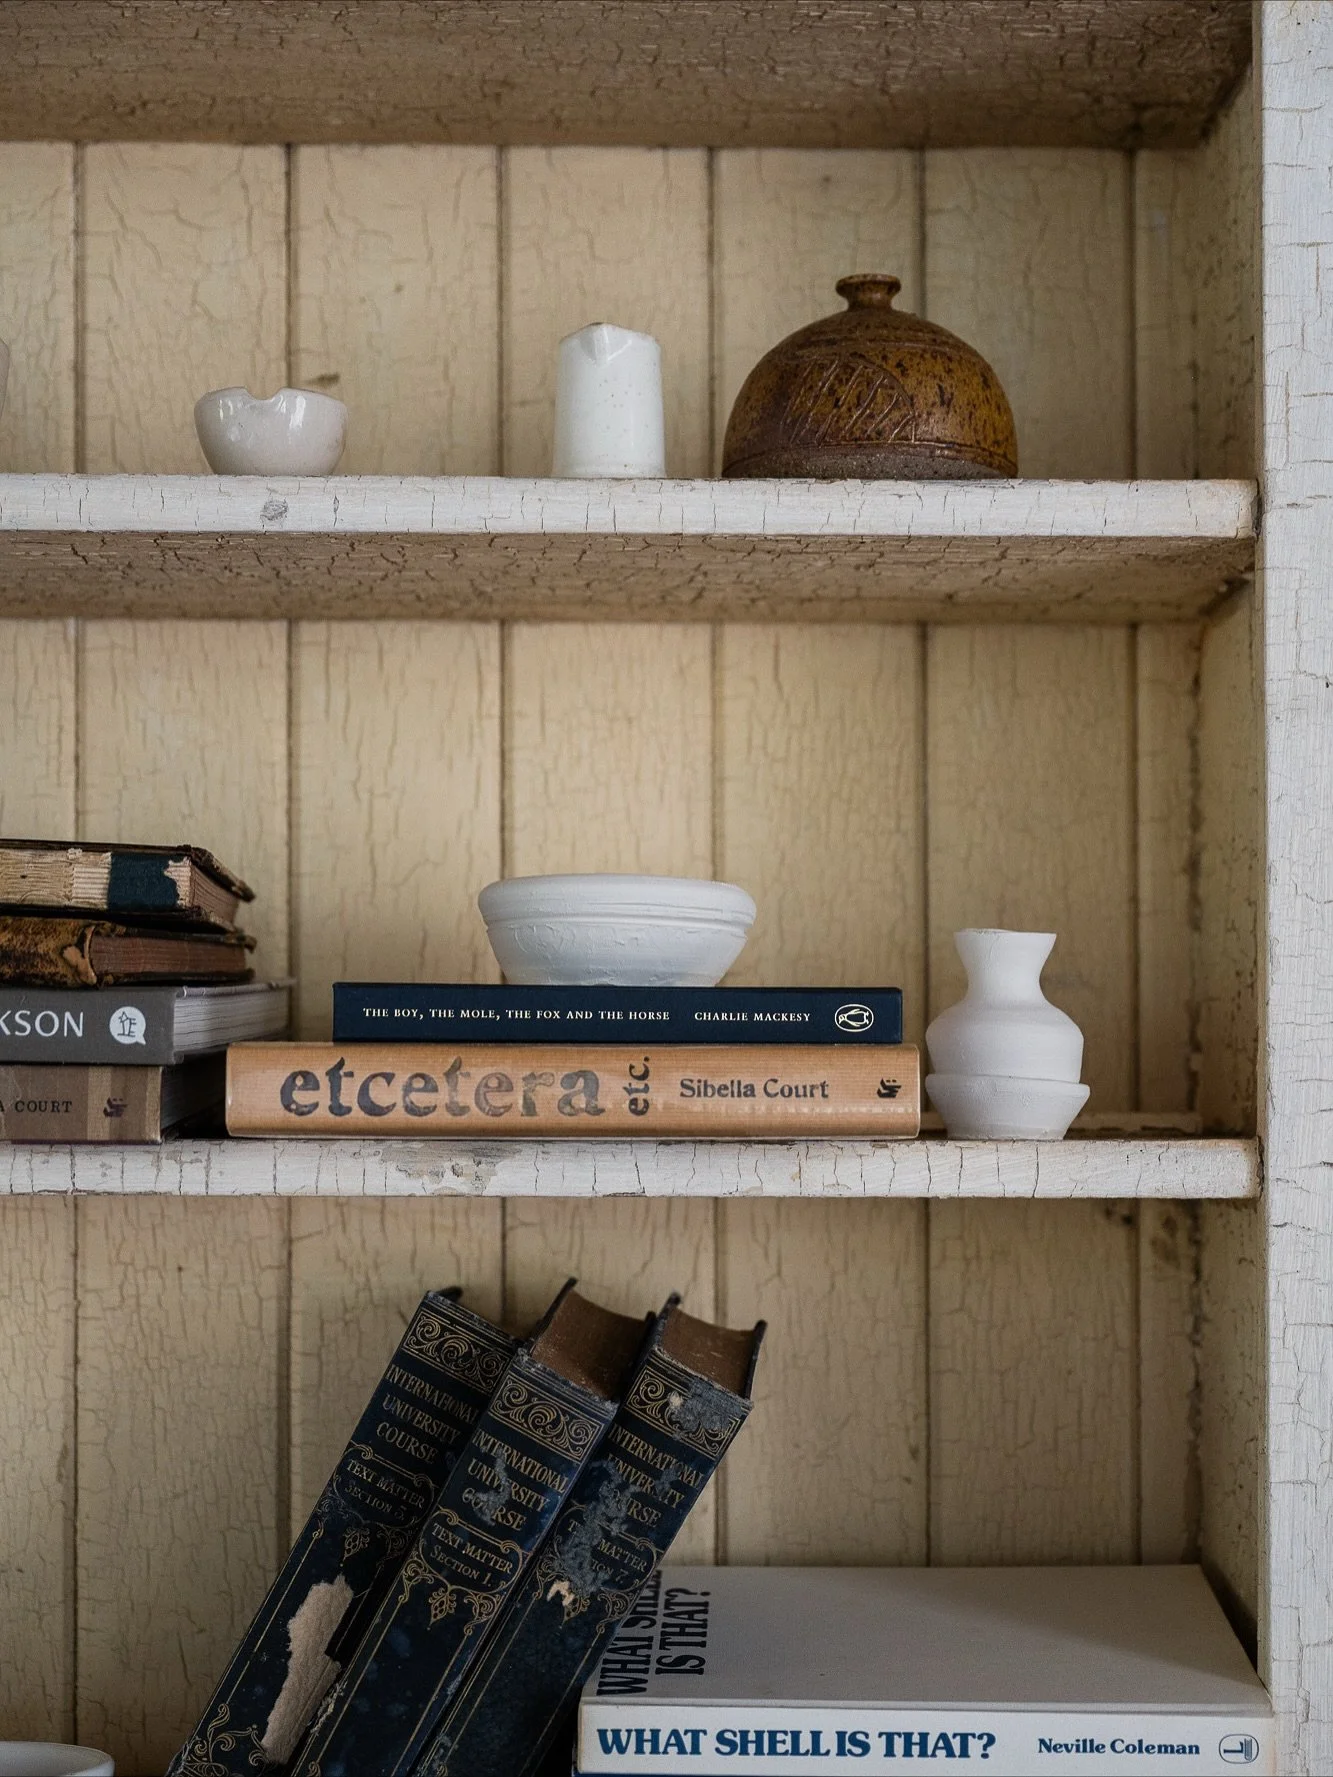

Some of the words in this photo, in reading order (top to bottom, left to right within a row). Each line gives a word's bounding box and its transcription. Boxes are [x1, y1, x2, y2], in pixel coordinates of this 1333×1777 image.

[363, 1008, 389, 1018] THE
[394, 1008, 424, 1020] BOY,
[429, 1008, 455, 1018] THE
[460, 1009, 500, 1021] MOLE,
[505, 1009, 531, 1019] THE
[536, 1009, 561, 1020] FOX
[566, 1010, 593, 1020] AND
[598, 1010, 624, 1020] THE
[629, 1011, 670, 1021] HORSE
[694, 1011, 749, 1022] CHARLIE
[753, 1012, 811, 1022] MACKESY
[15, 1100, 73, 1113] COURT
[279, 1056, 606, 1117] etcetera
[622, 1055, 650, 1116] etc.
[679, 1078, 756, 1099] Sibella
[763, 1078, 829, 1099] Court
[385, 1363, 479, 1425] INTERNATIONAL
[382, 1392, 462, 1446] UNIVERSITY
[376, 1421, 439, 1465] COURSE
[471, 1428, 570, 1494] INTERNATIONAL
[345, 1459, 377, 1482] TEXT
[376, 1476, 425, 1509] MATTER
[462, 1487, 527, 1531] CORSE
[431, 1522, 463, 1549] TEXT
[462, 1542, 513, 1574] MATTER
[659, 1587, 711, 1651] THAT?
[596, 1636, 654, 1696] WHAT
[655, 1654, 706, 1676] IS
[597, 1728, 707, 1756] WHAT
[715, 1728, 831, 1757] SHELL
[836, 1730, 871, 1758] IS
[878, 1731, 997, 1760] THAT?
[1038, 1737, 1106, 1754] Neville
[1109, 1738, 1200, 1755] Coleman
